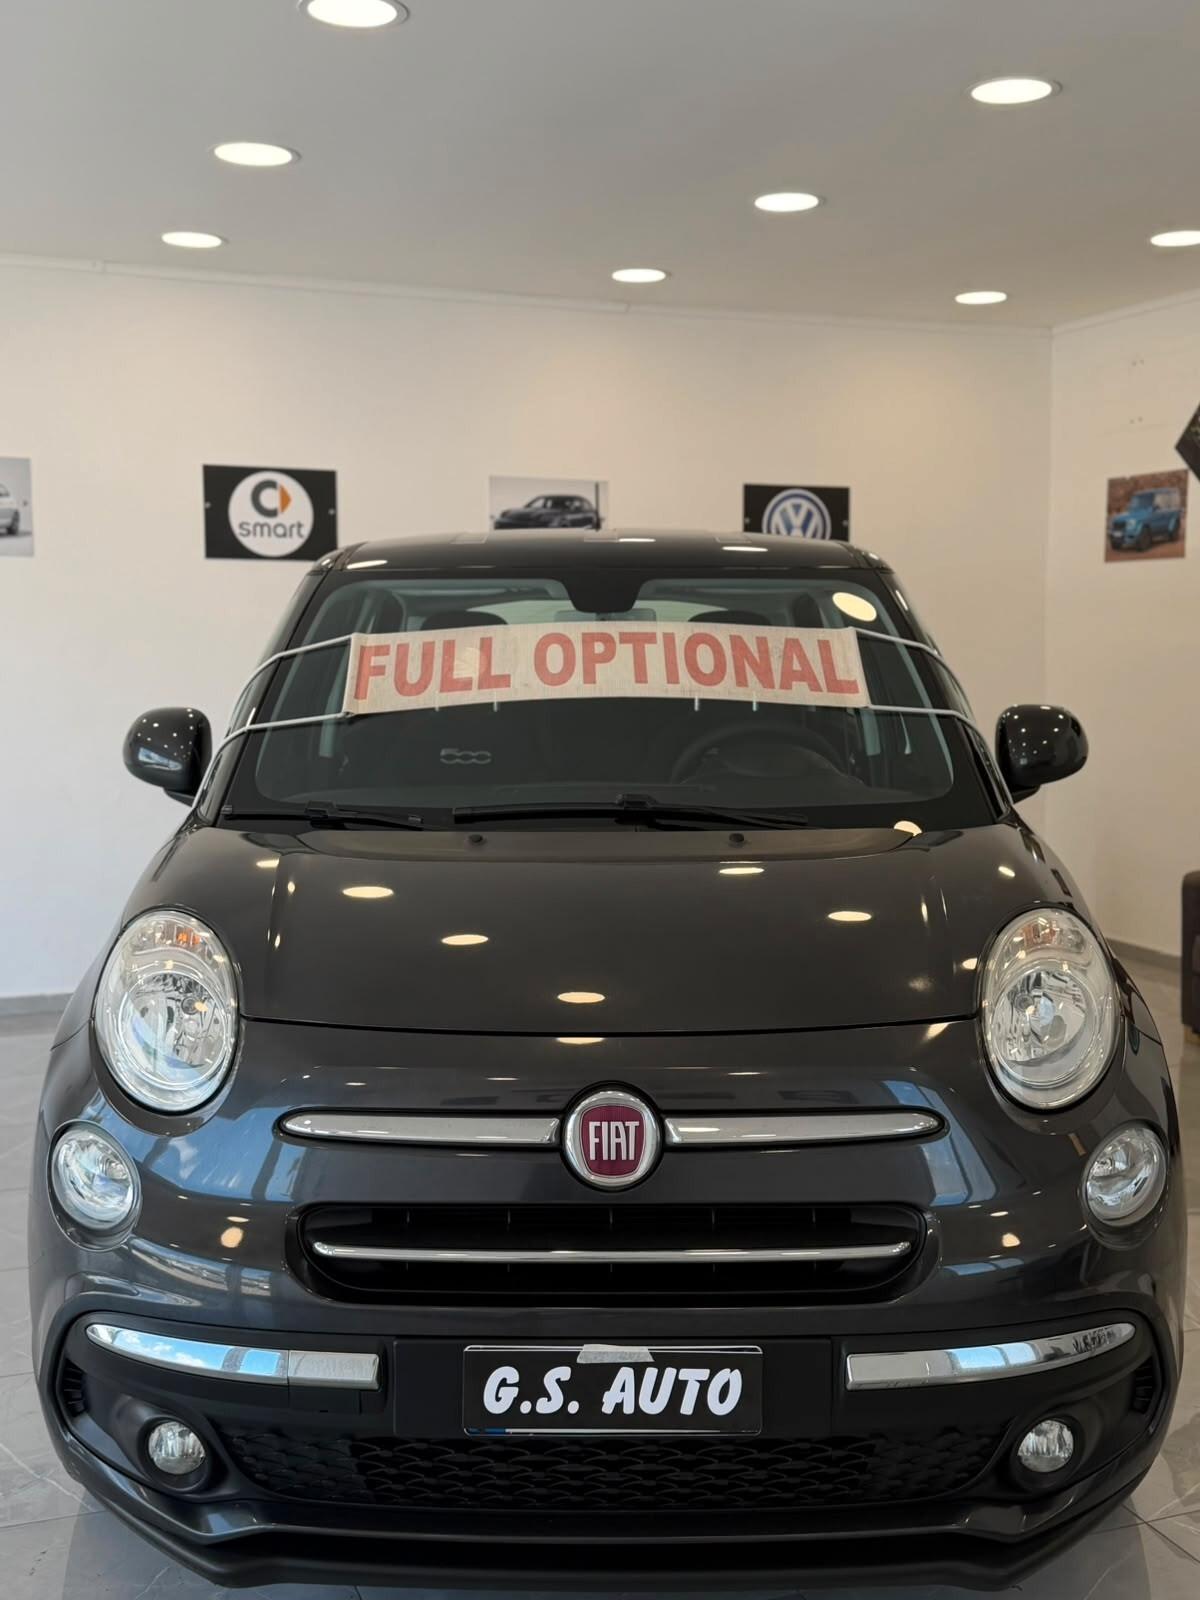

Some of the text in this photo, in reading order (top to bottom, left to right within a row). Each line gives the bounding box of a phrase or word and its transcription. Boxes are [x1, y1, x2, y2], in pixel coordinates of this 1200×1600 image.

[238, 521, 304, 539] smart
[354, 631, 860, 700] FULL OPTIONAL
[440, 748, 492, 764] 500
[588, 1121, 640, 1161] FIAT
[483, 1366, 743, 1416] G.S. AUTO
